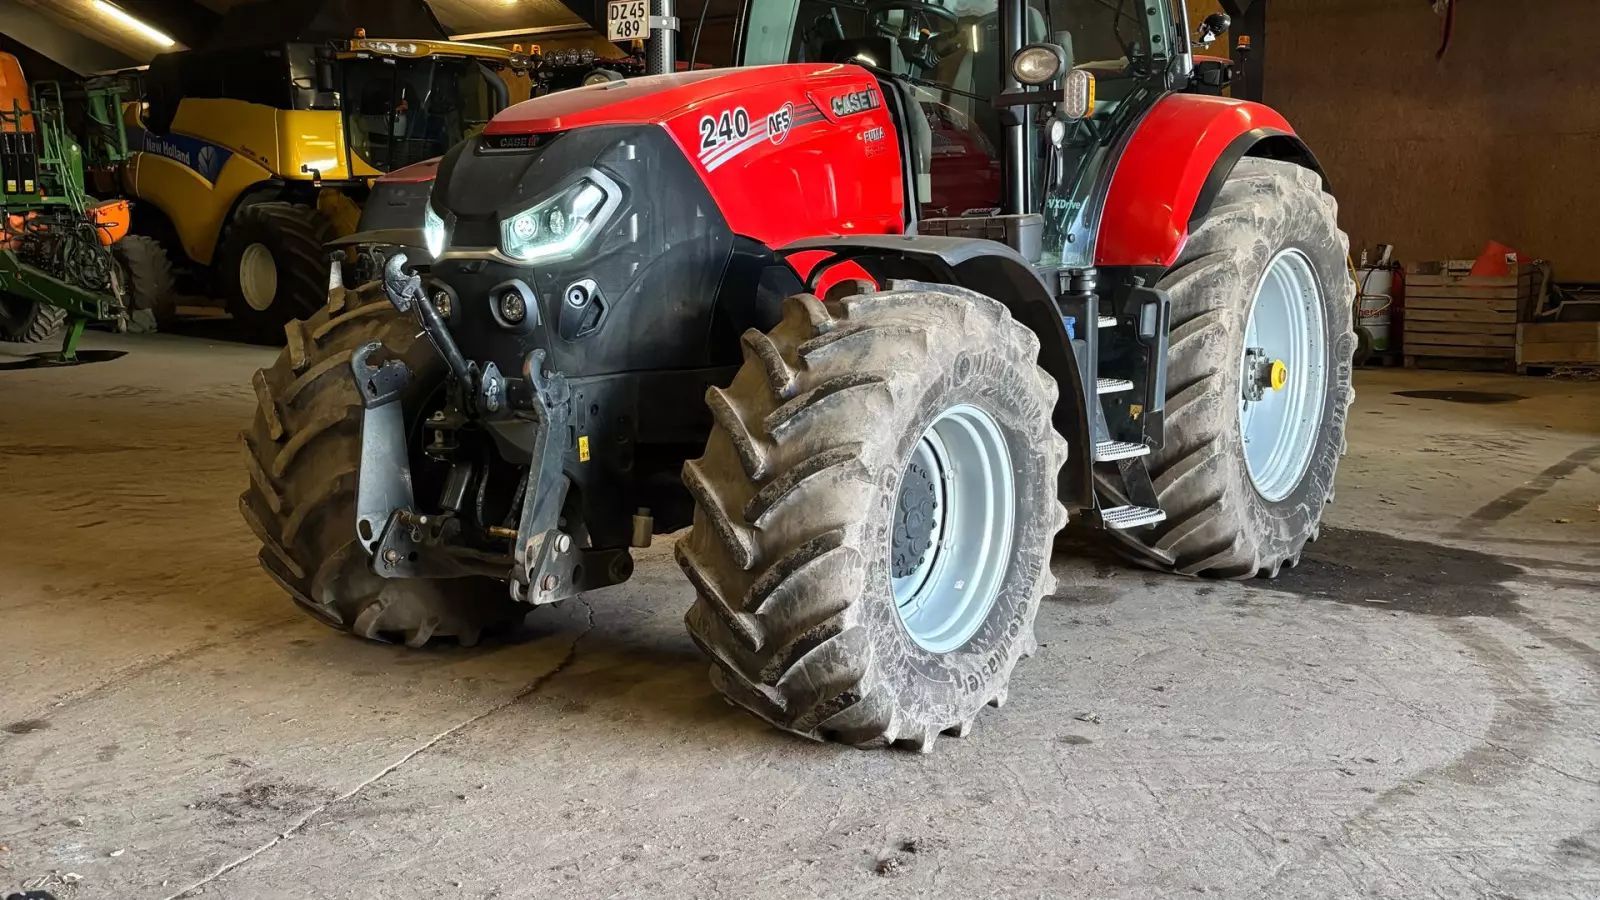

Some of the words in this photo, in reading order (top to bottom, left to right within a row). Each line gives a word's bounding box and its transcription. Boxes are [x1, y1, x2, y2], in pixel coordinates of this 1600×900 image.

[616, 20, 640, 37] 489
[831, 92, 869, 116] CASE
[700, 107, 750, 150] 240
[767, 110, 791, 137] AFS
[146, 137, 162, 153] New
[162, 141, 191, 165] Holland
[500, 137, 527, 147] CASE
